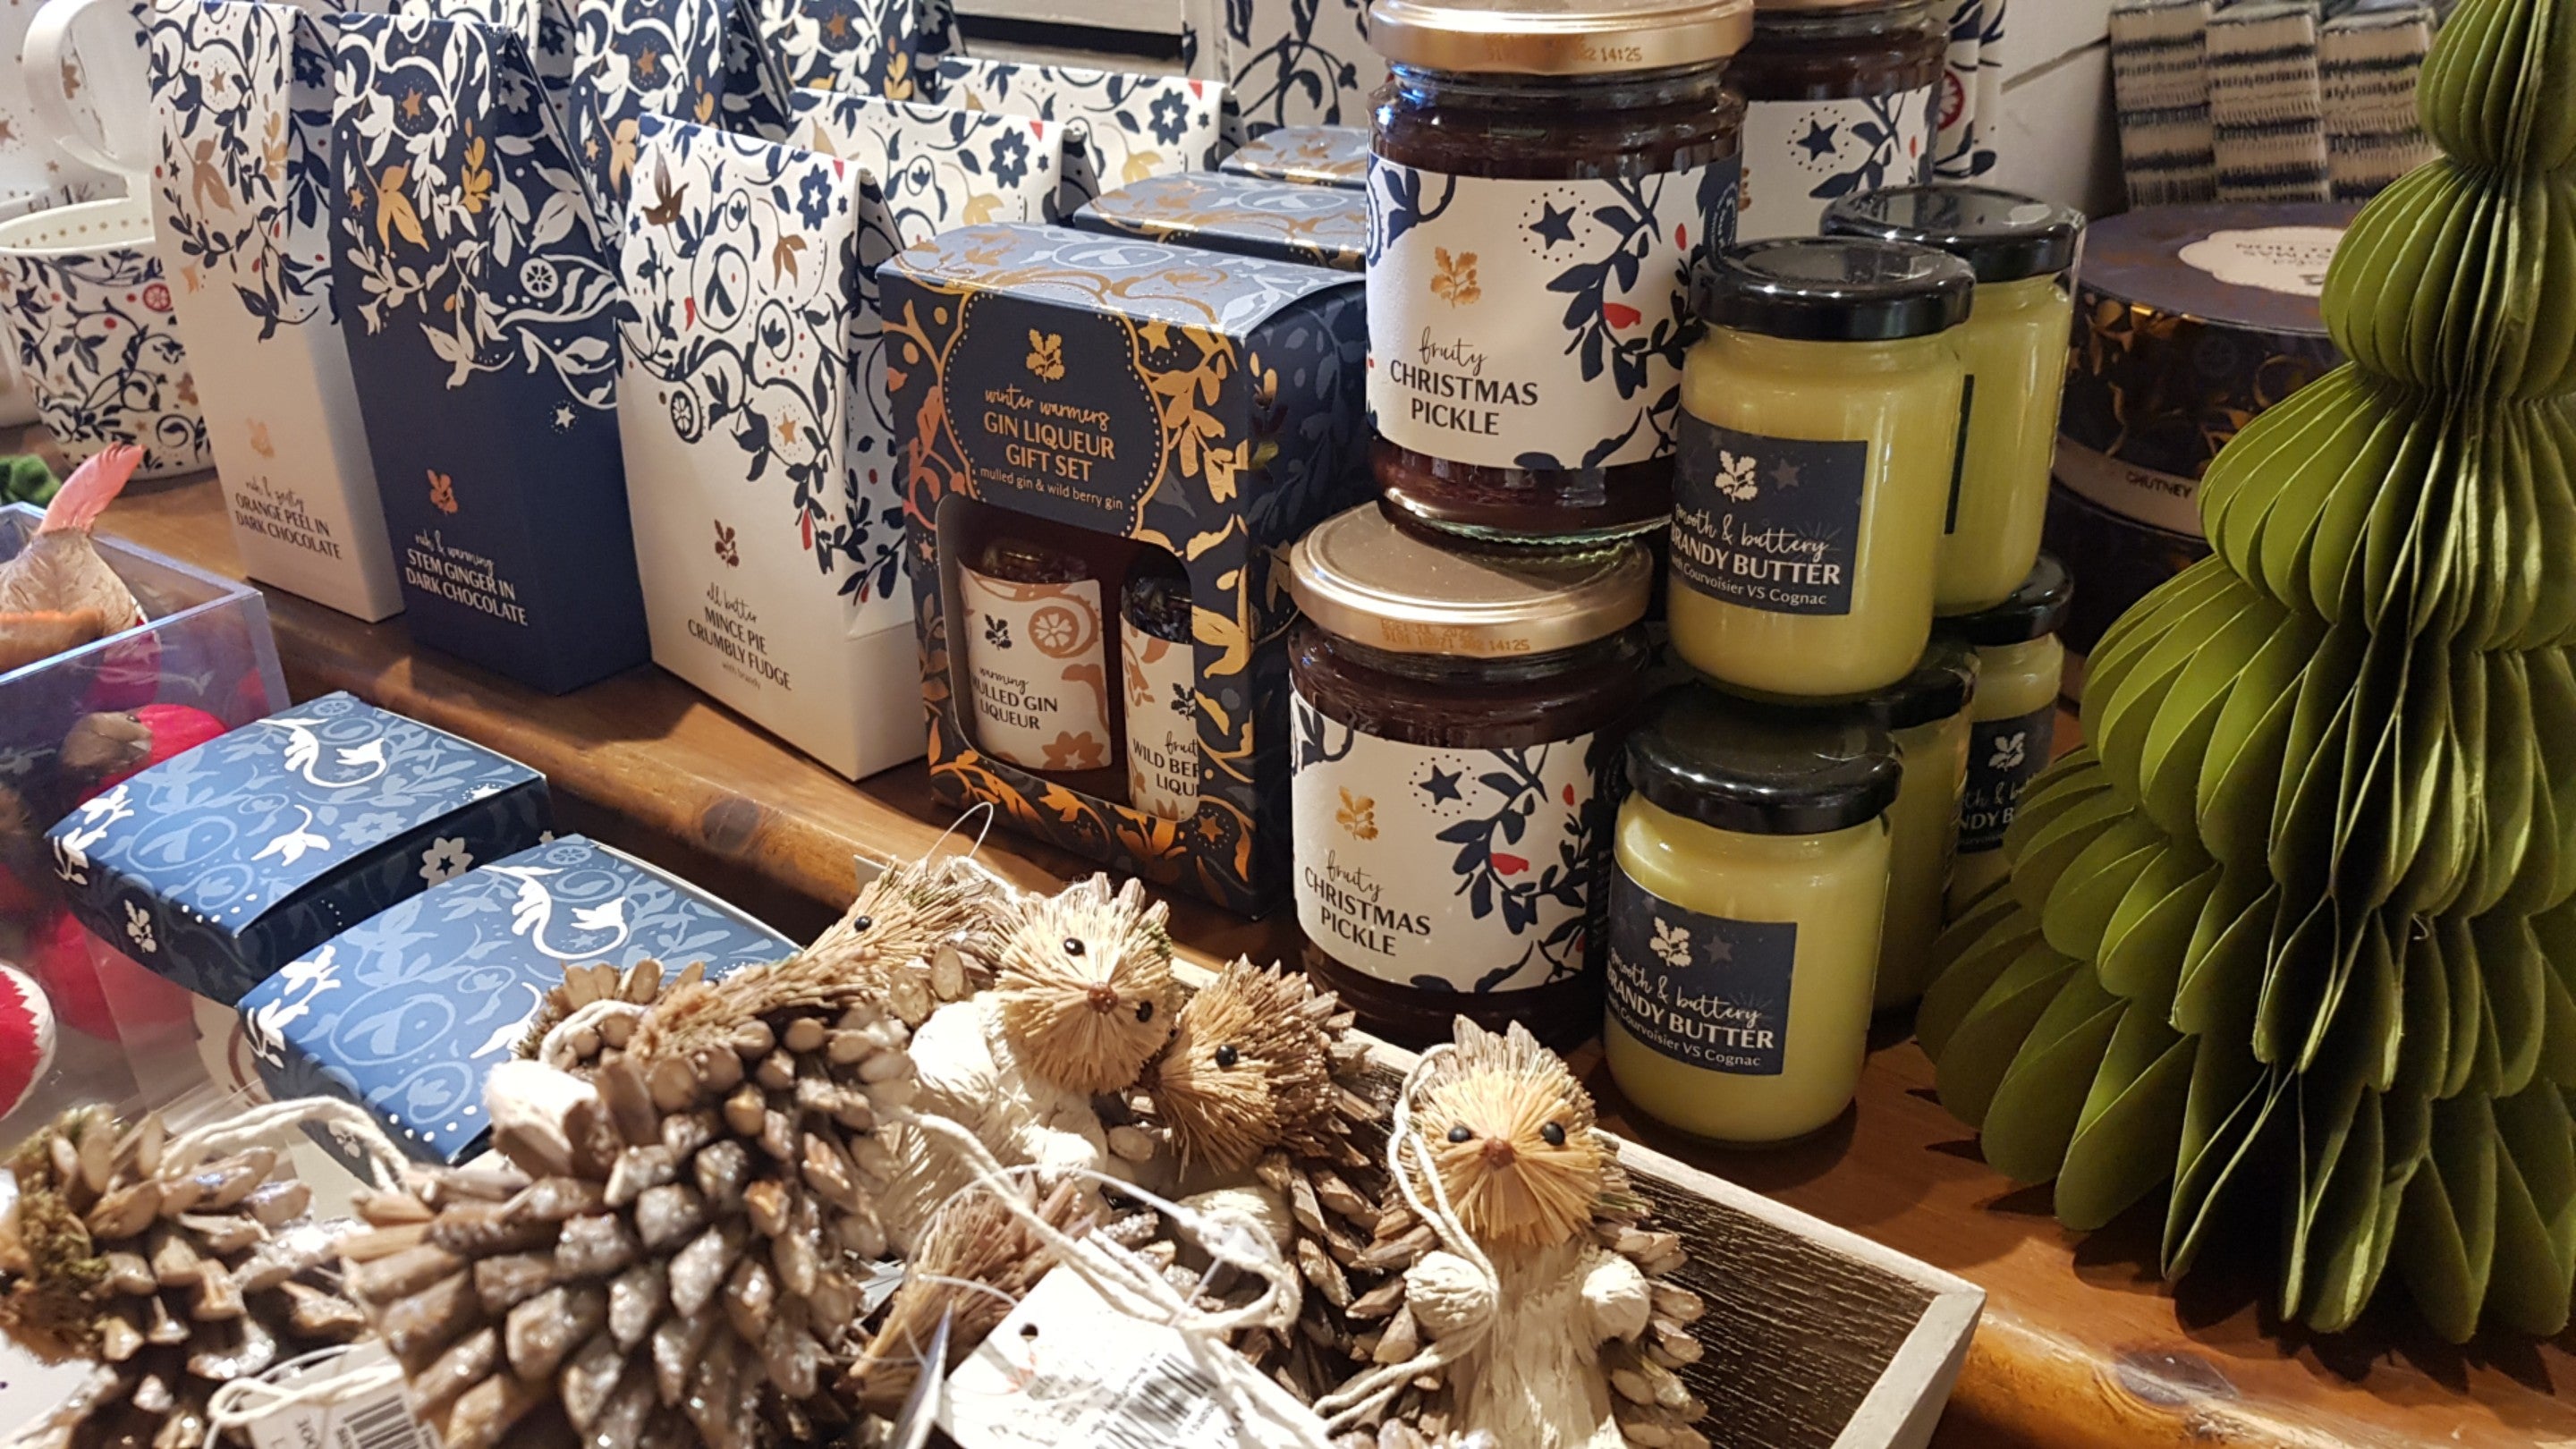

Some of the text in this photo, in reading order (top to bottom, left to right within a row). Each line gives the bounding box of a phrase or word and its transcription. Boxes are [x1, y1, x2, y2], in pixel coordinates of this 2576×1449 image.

[1419, 326, 1488, 377] fruity
[985, 383, 1110, 432] winter warmers
[1390, 360, 1538, 406] CHRISTMAS
[984, 411, 1115, 461] GIN LIQUEUR
[1411, 397, 1500, 436] PICKLE
[1006, 444, 1093, 482] GIFT SET
[980, 467, 1123, 511] mulled gin & wild berry gin
[235, 492, 331, 537] ORANGE PEEL IN
[235, 511, 343, 560] DARK CHOCOLATE
[1721, 513, 1733, 546] &
[1741, 522, 1830, 564] buttery
[407, 548, 516, 601] STEM GINGER IN
[1682, 563, 1744, 596] Courvoisier
[1747, 584, 1766, 600] VS
[1769, 588, 1827, 606] Cognac
[1733, 553, 1841, 586] BUTTER
[405, 567, 529, 626] DARK CHOCOLATE
[688, 618, 745, 664] CRUMBLY
[748, 651, 792, 691] FUDGE
[704, 606, 767, 656] MINCE PIE
[979, 699, 1040, 730] LIQUEUR
[1023, 695, 1058, 712] GIN
[1132, 737, 1165, 768] WILD
[1326, 849, 1384, 902] fruity
[1305, 866, 1431, 936] CHRISTMAS
[1321, 905, 1396, 957] PICKLE
[1657, 975, 1669, 1004] &
[1676, 987, 1762, 1030] buttery
[1620, 1006, 1679, 1051] Courvoisier
[1682, 1041, 1701, 1057] VS
[1704, 1048, 1762, 1067] Cognac
[1668, 1012, 1775, 1049] BUTTER
